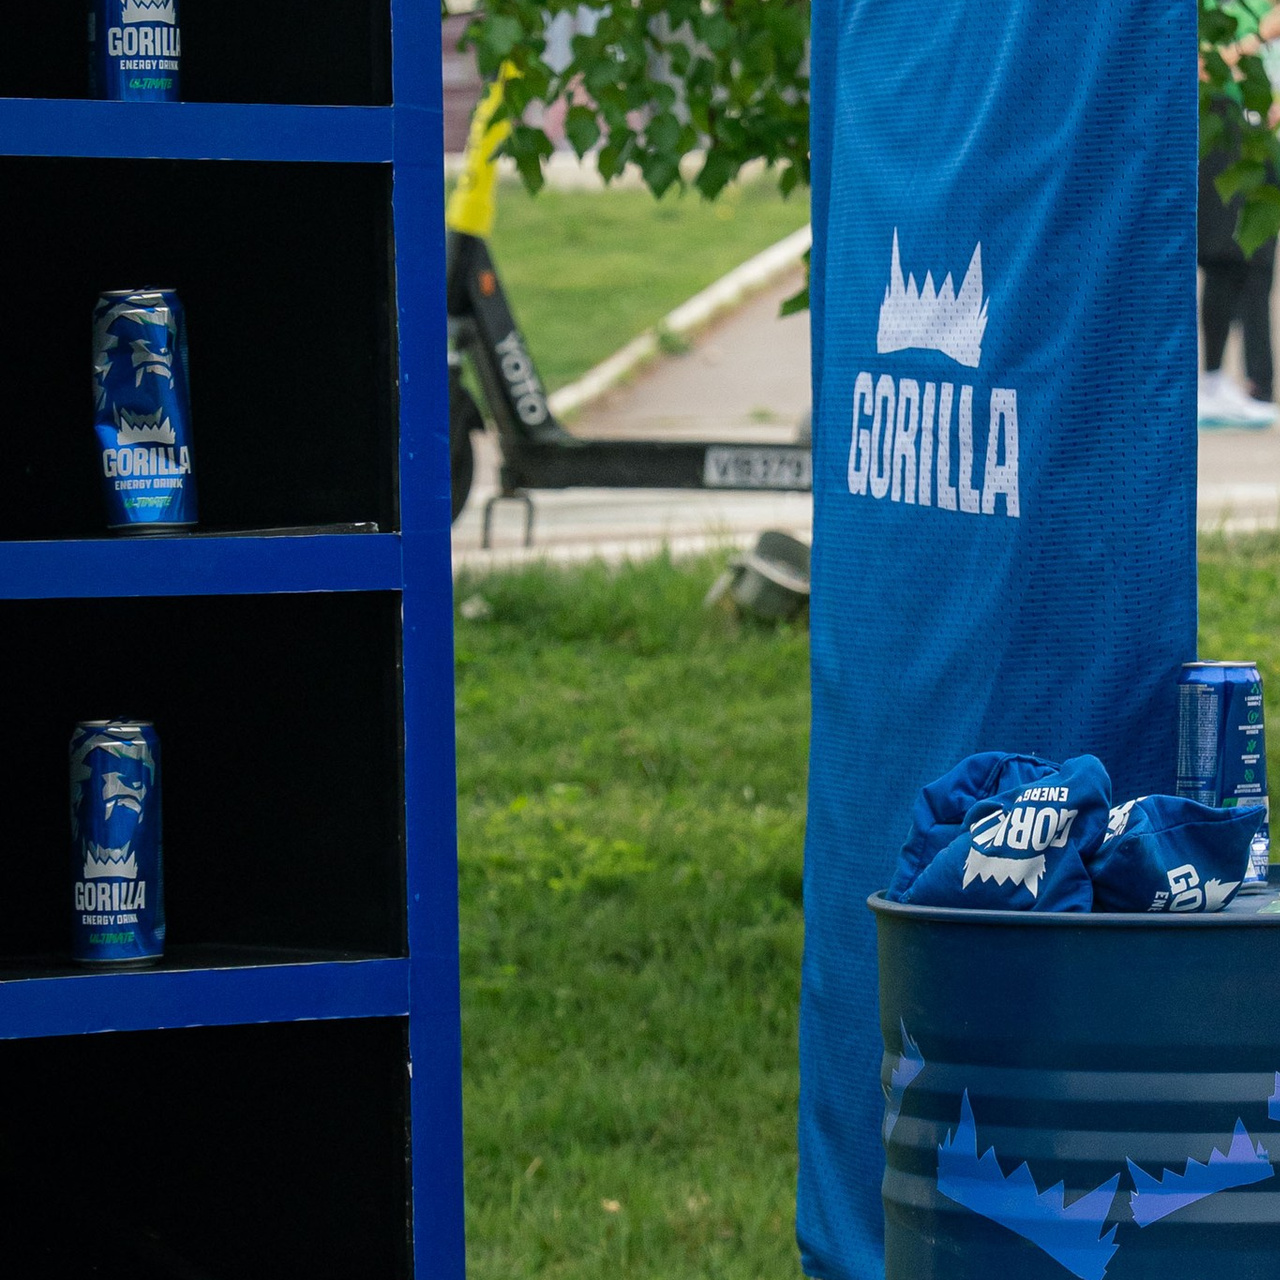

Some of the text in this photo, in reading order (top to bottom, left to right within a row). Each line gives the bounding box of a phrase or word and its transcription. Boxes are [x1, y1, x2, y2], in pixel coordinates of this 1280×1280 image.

[120, 60, 157, 70] ENERGY
[848, 371, 1020, 517] GORILLA
[103, 446, 191, 477] GORILLA
[115, 478, 183, 490] ENERGY DRINK
[75, 881, 145, 911] GORILLA
[82, 915, 115, 925] ENERGY
